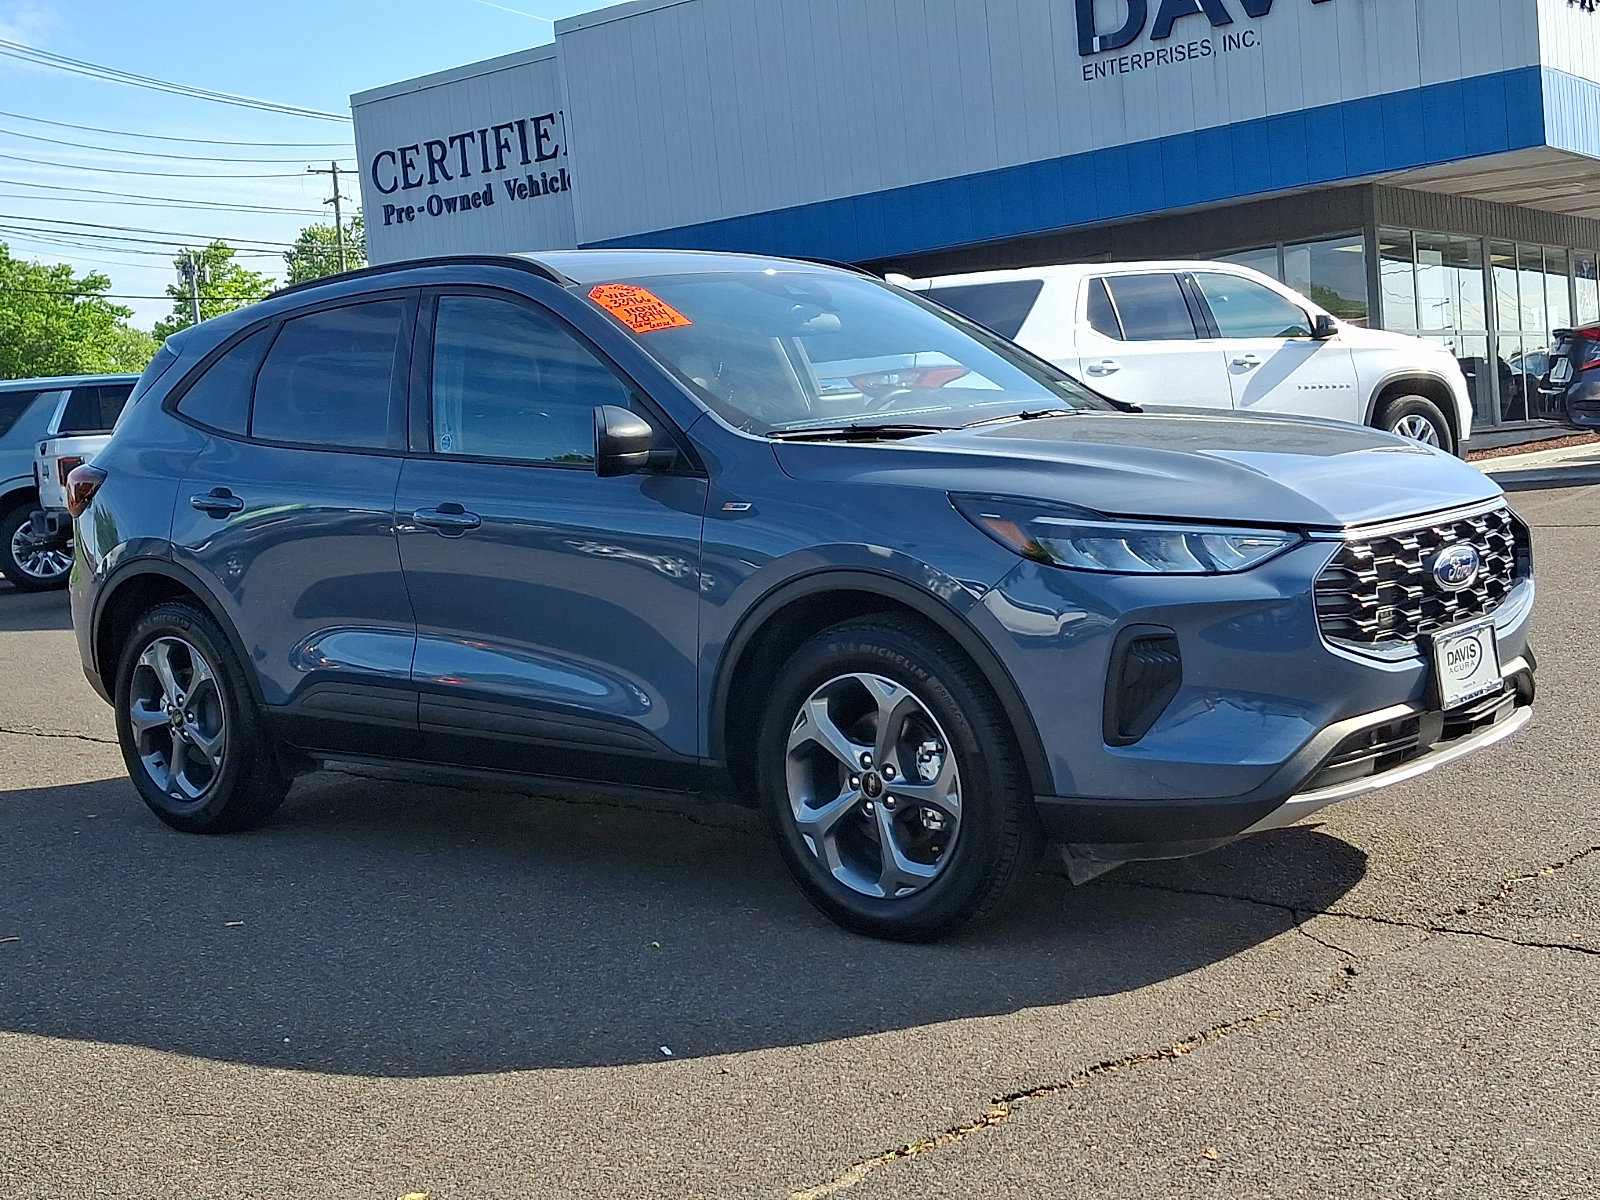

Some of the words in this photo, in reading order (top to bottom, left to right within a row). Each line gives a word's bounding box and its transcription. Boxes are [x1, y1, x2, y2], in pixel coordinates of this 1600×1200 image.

[1076, 0, 1332, 56] DA
[1082, 38, 1217, 81] ENTERPRISES,
[1223, 30, 1262, 53] INC.
[371, 110, 568, 195] CERTIFIE
[382, 183, 495, 226] Pre-Owned
[859, 643, 929, 679] MICHELIN
[1446, 643, 1477, 667] DAVIS
[1448, 660, 1476, 675] ACURA
